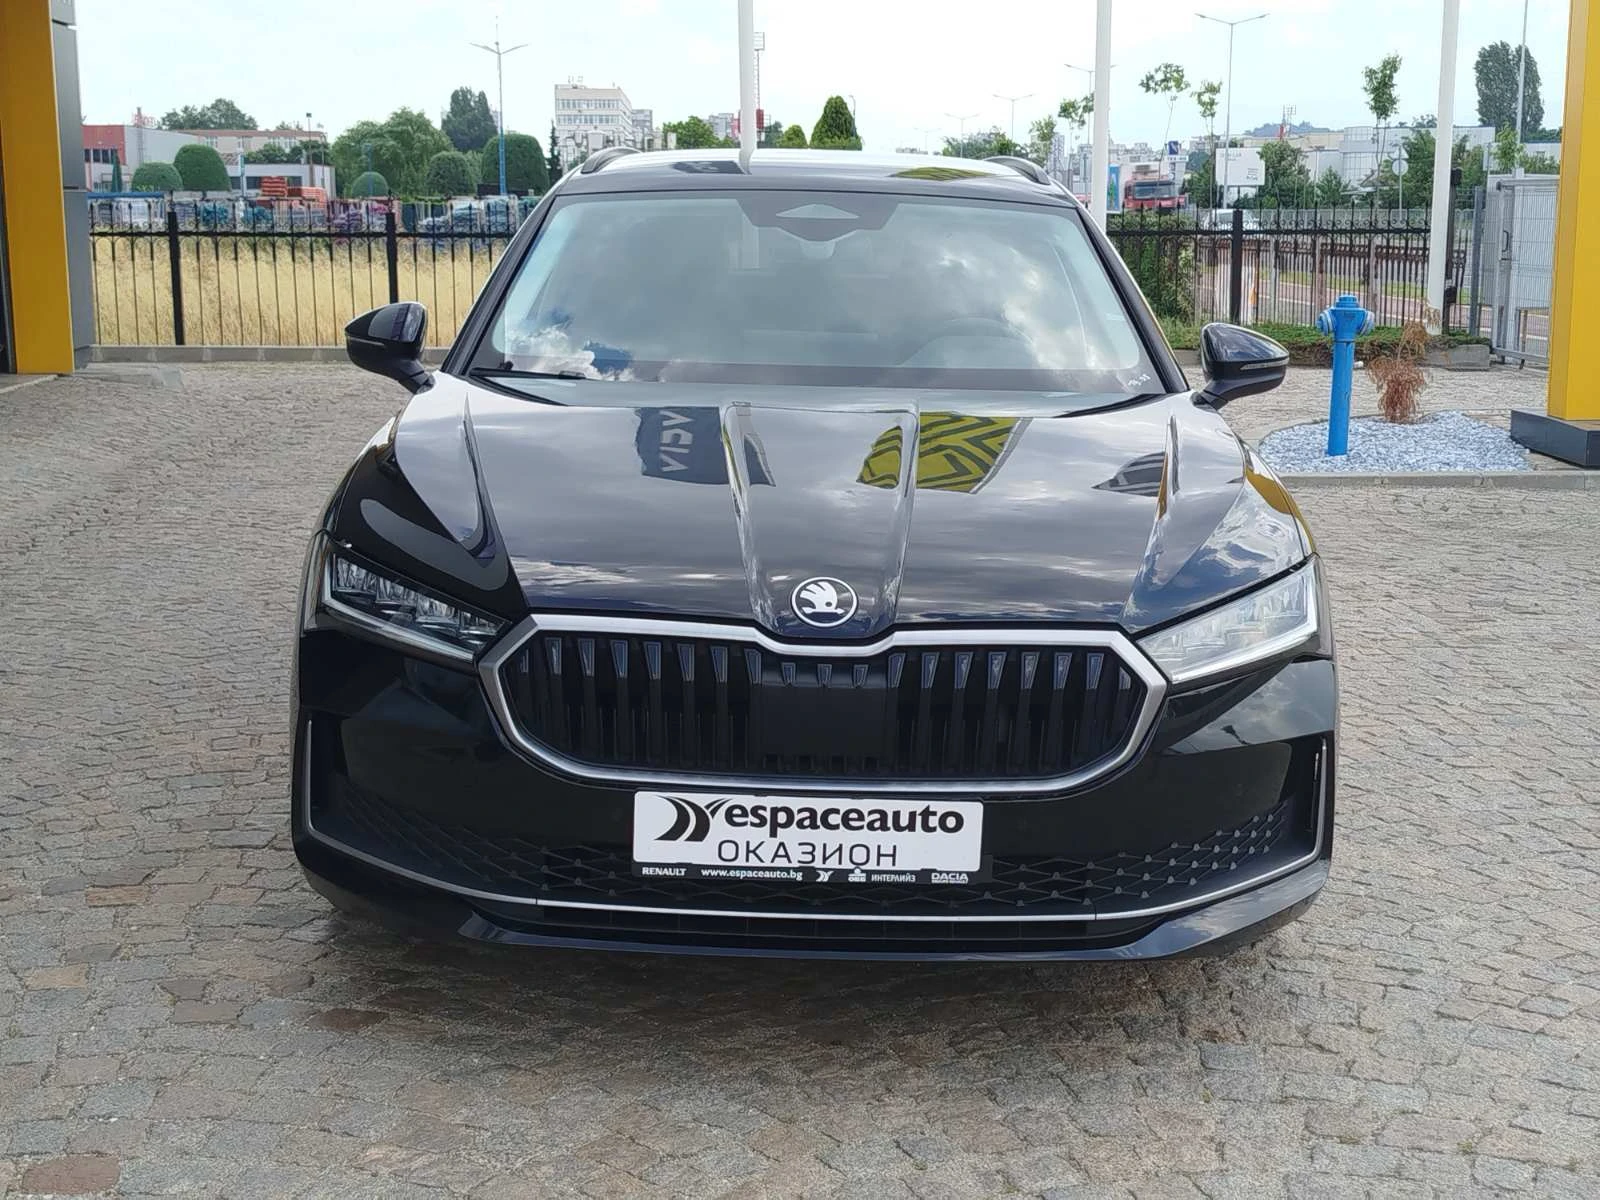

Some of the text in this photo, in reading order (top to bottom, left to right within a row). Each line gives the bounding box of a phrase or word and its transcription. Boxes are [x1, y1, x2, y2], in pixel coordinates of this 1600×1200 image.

[724, 804, 964, 838] espaceauto
[717, 839, 897, 867] ОКАЗИОН
[642, 867, 687, 876] RENAULT
[701, 869, 803, 881] www.espaceauto.bg
[931, 872, 968, 881] DACIA
